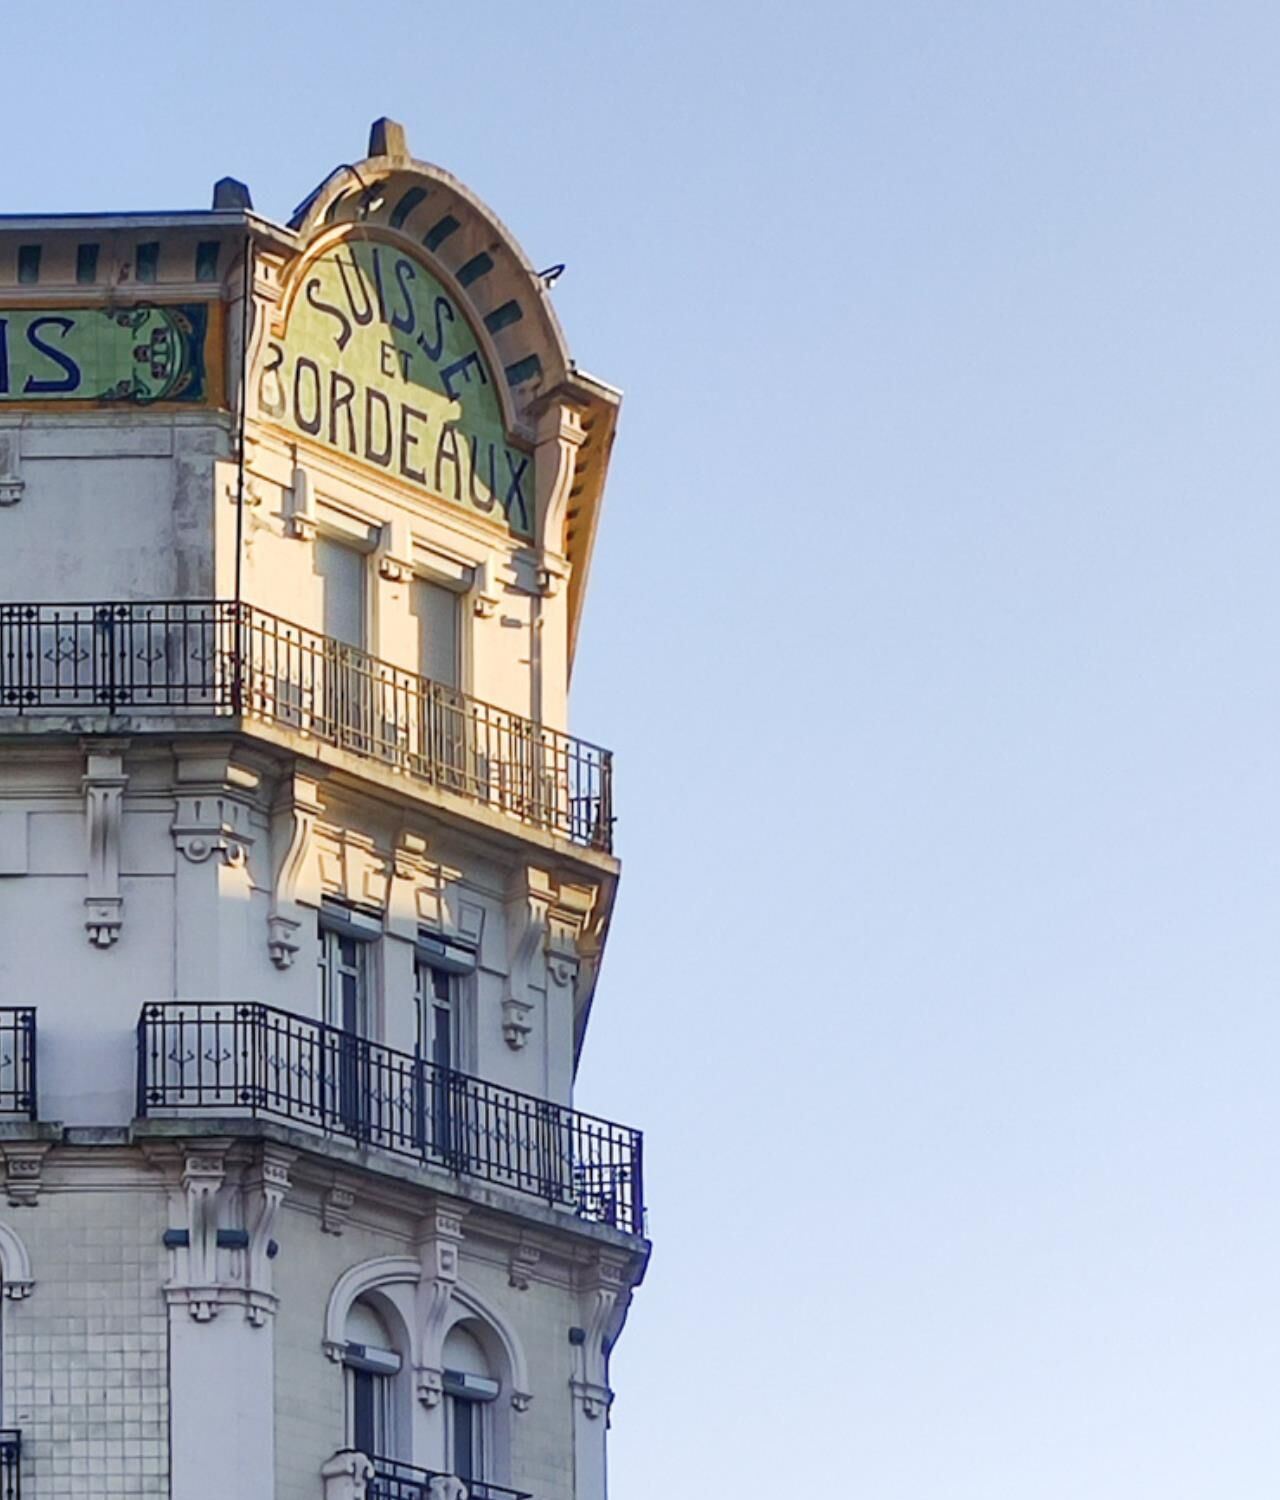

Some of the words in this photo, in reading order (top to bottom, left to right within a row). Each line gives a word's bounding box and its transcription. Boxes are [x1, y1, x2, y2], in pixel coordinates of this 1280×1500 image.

[306, 246, 487, 404] SUISSE
[380, 340, 413, 384] ET
[258, 342, 528, 531] BORDEAUX
